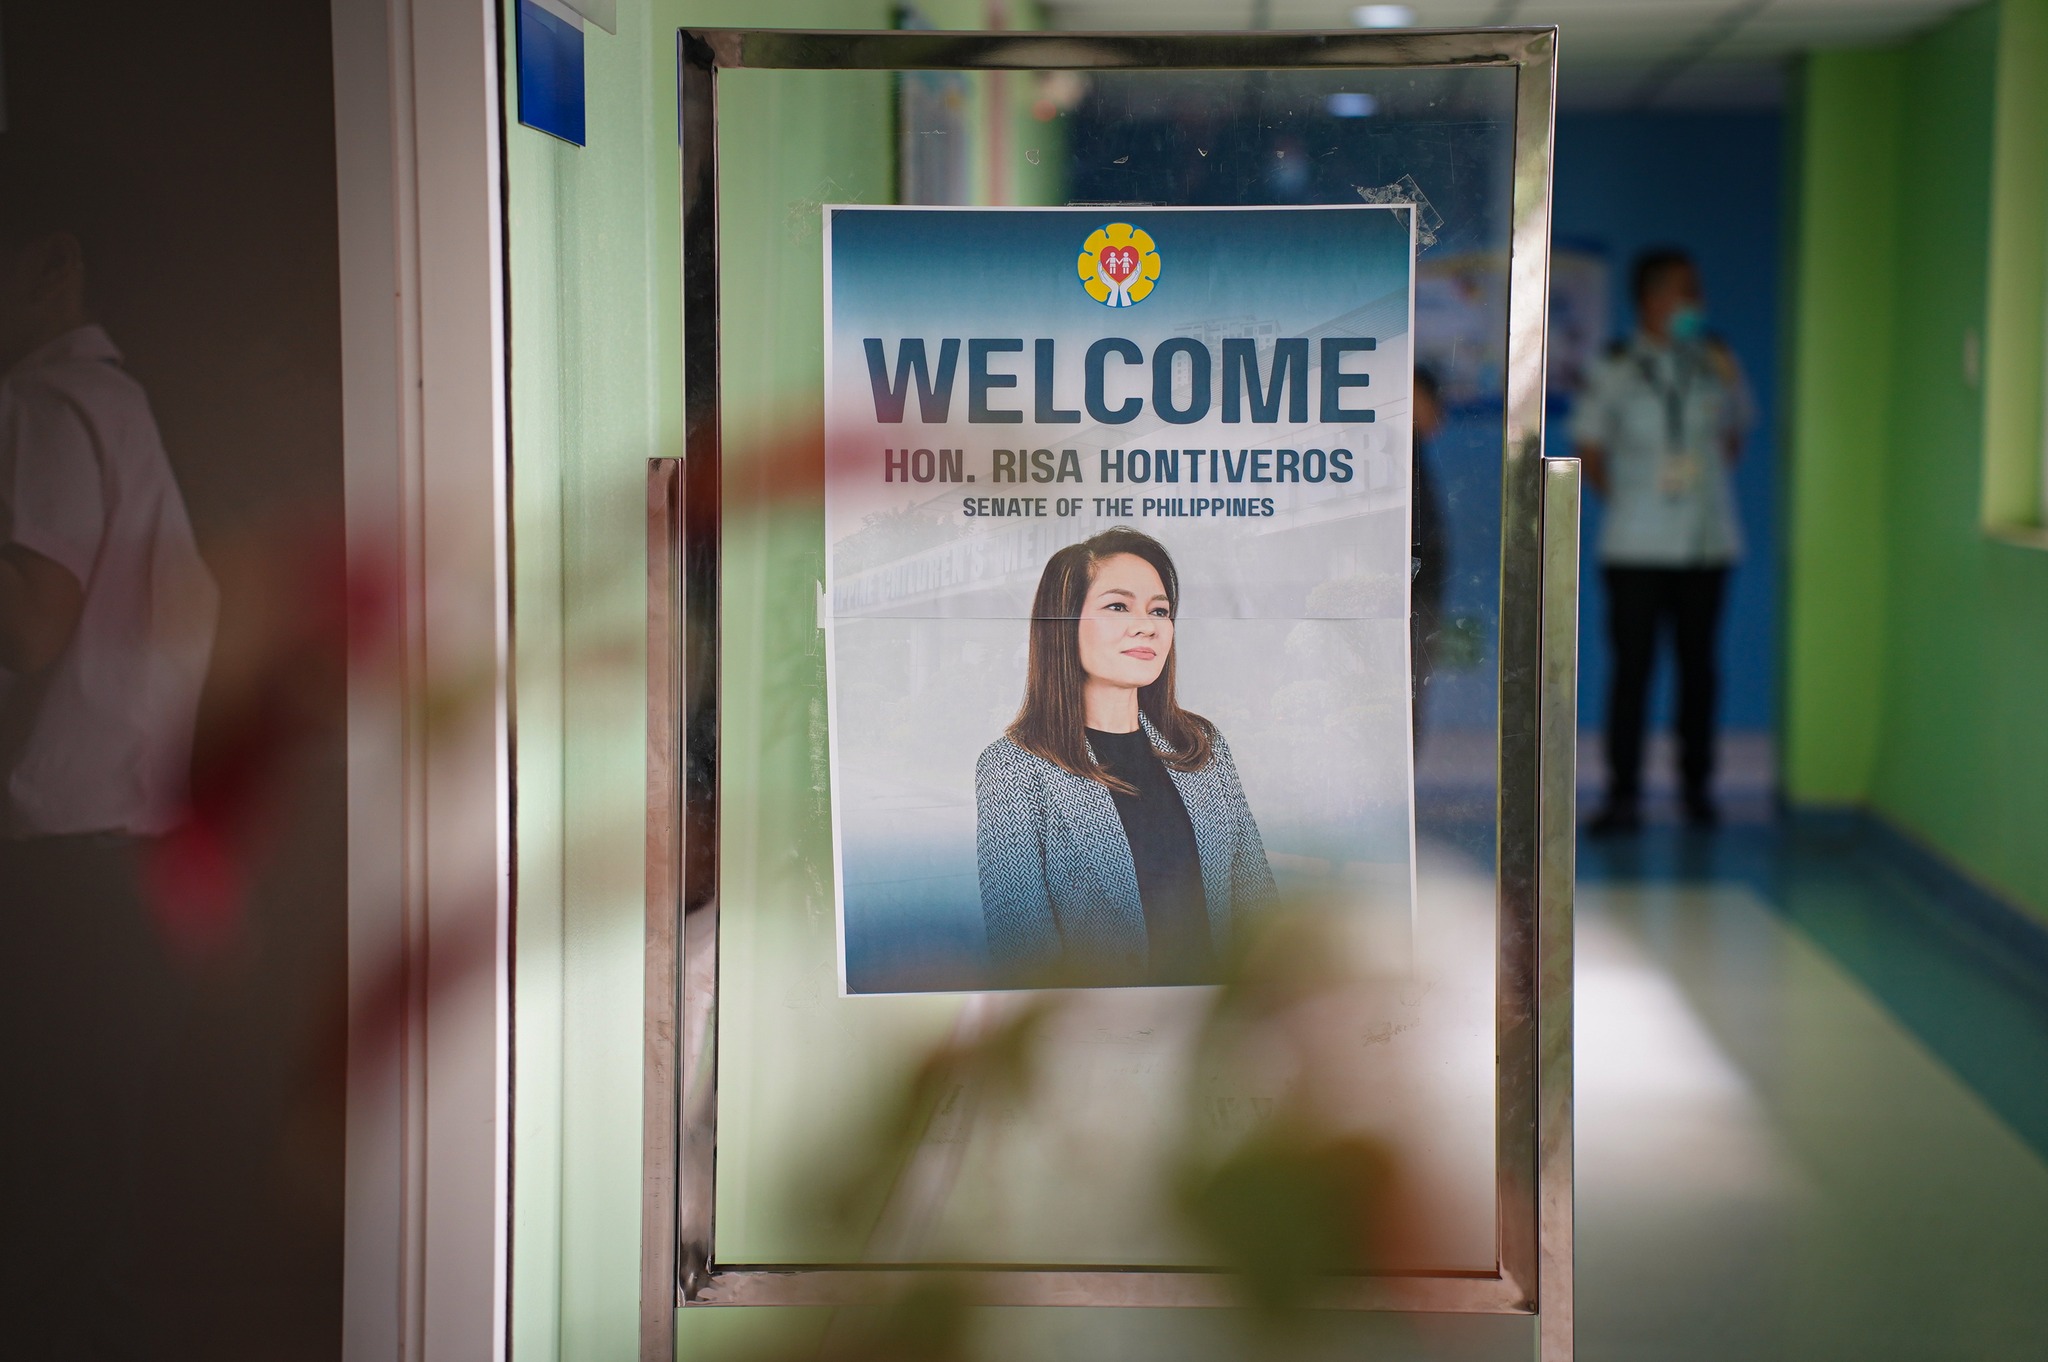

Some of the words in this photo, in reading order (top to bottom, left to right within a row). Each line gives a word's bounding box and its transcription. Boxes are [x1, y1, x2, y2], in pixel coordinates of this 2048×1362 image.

[862, 337, 1377, 424] WELCOME
[884, 448, 975, 483] HON.
[992, 448, 1082, 483] RISA
[1100, 448, 1354, 483] HONTIVEROS
[963, 497, 1047, 517] SENATE
[1056, 497, 1082, 517] OF
[1092, 497, 1133, 517] THE
[1142, 497, 1275, 517] PHILIPPINES
